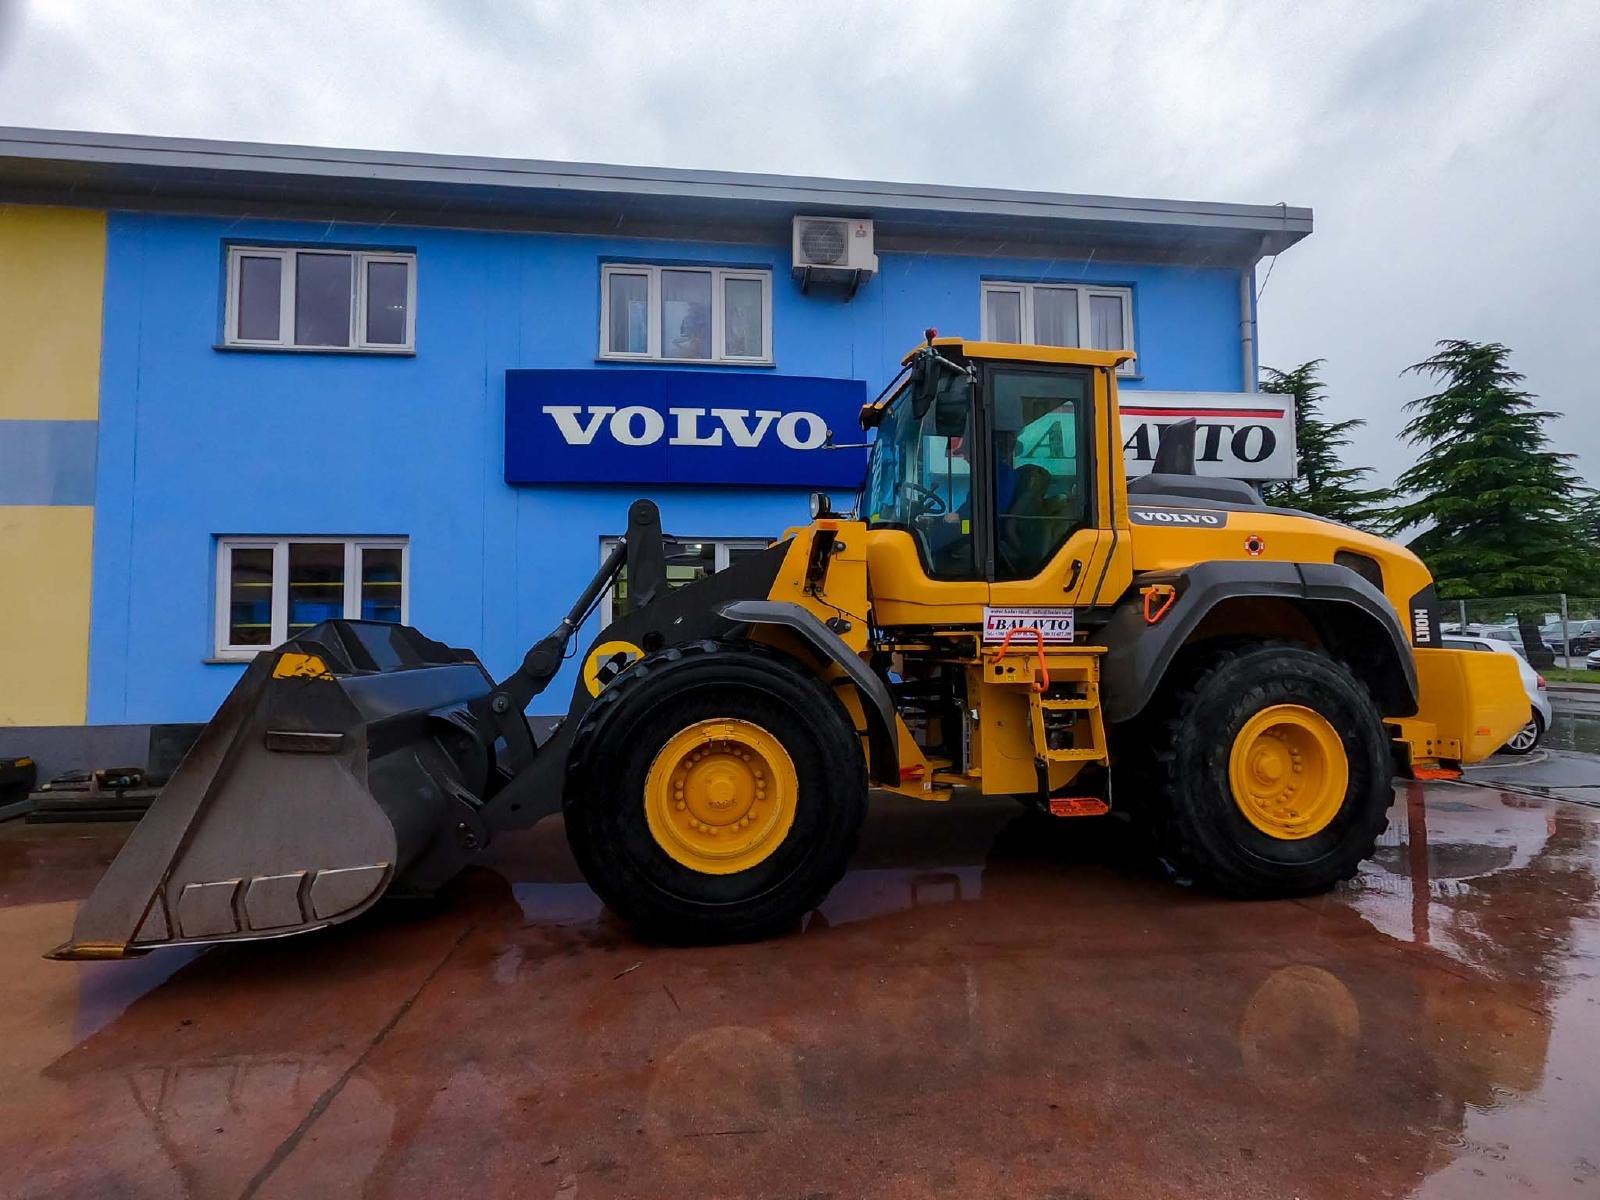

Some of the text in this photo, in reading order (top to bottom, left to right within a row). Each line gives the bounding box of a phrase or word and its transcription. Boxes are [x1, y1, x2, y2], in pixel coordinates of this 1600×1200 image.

[543, 405, 828, 450] VOLVO
[1133, 511, 1219, 524] VOLVO
[1029, 619, 1070, 630] AVTO
[1414, 608, 1430, 642] L110H
